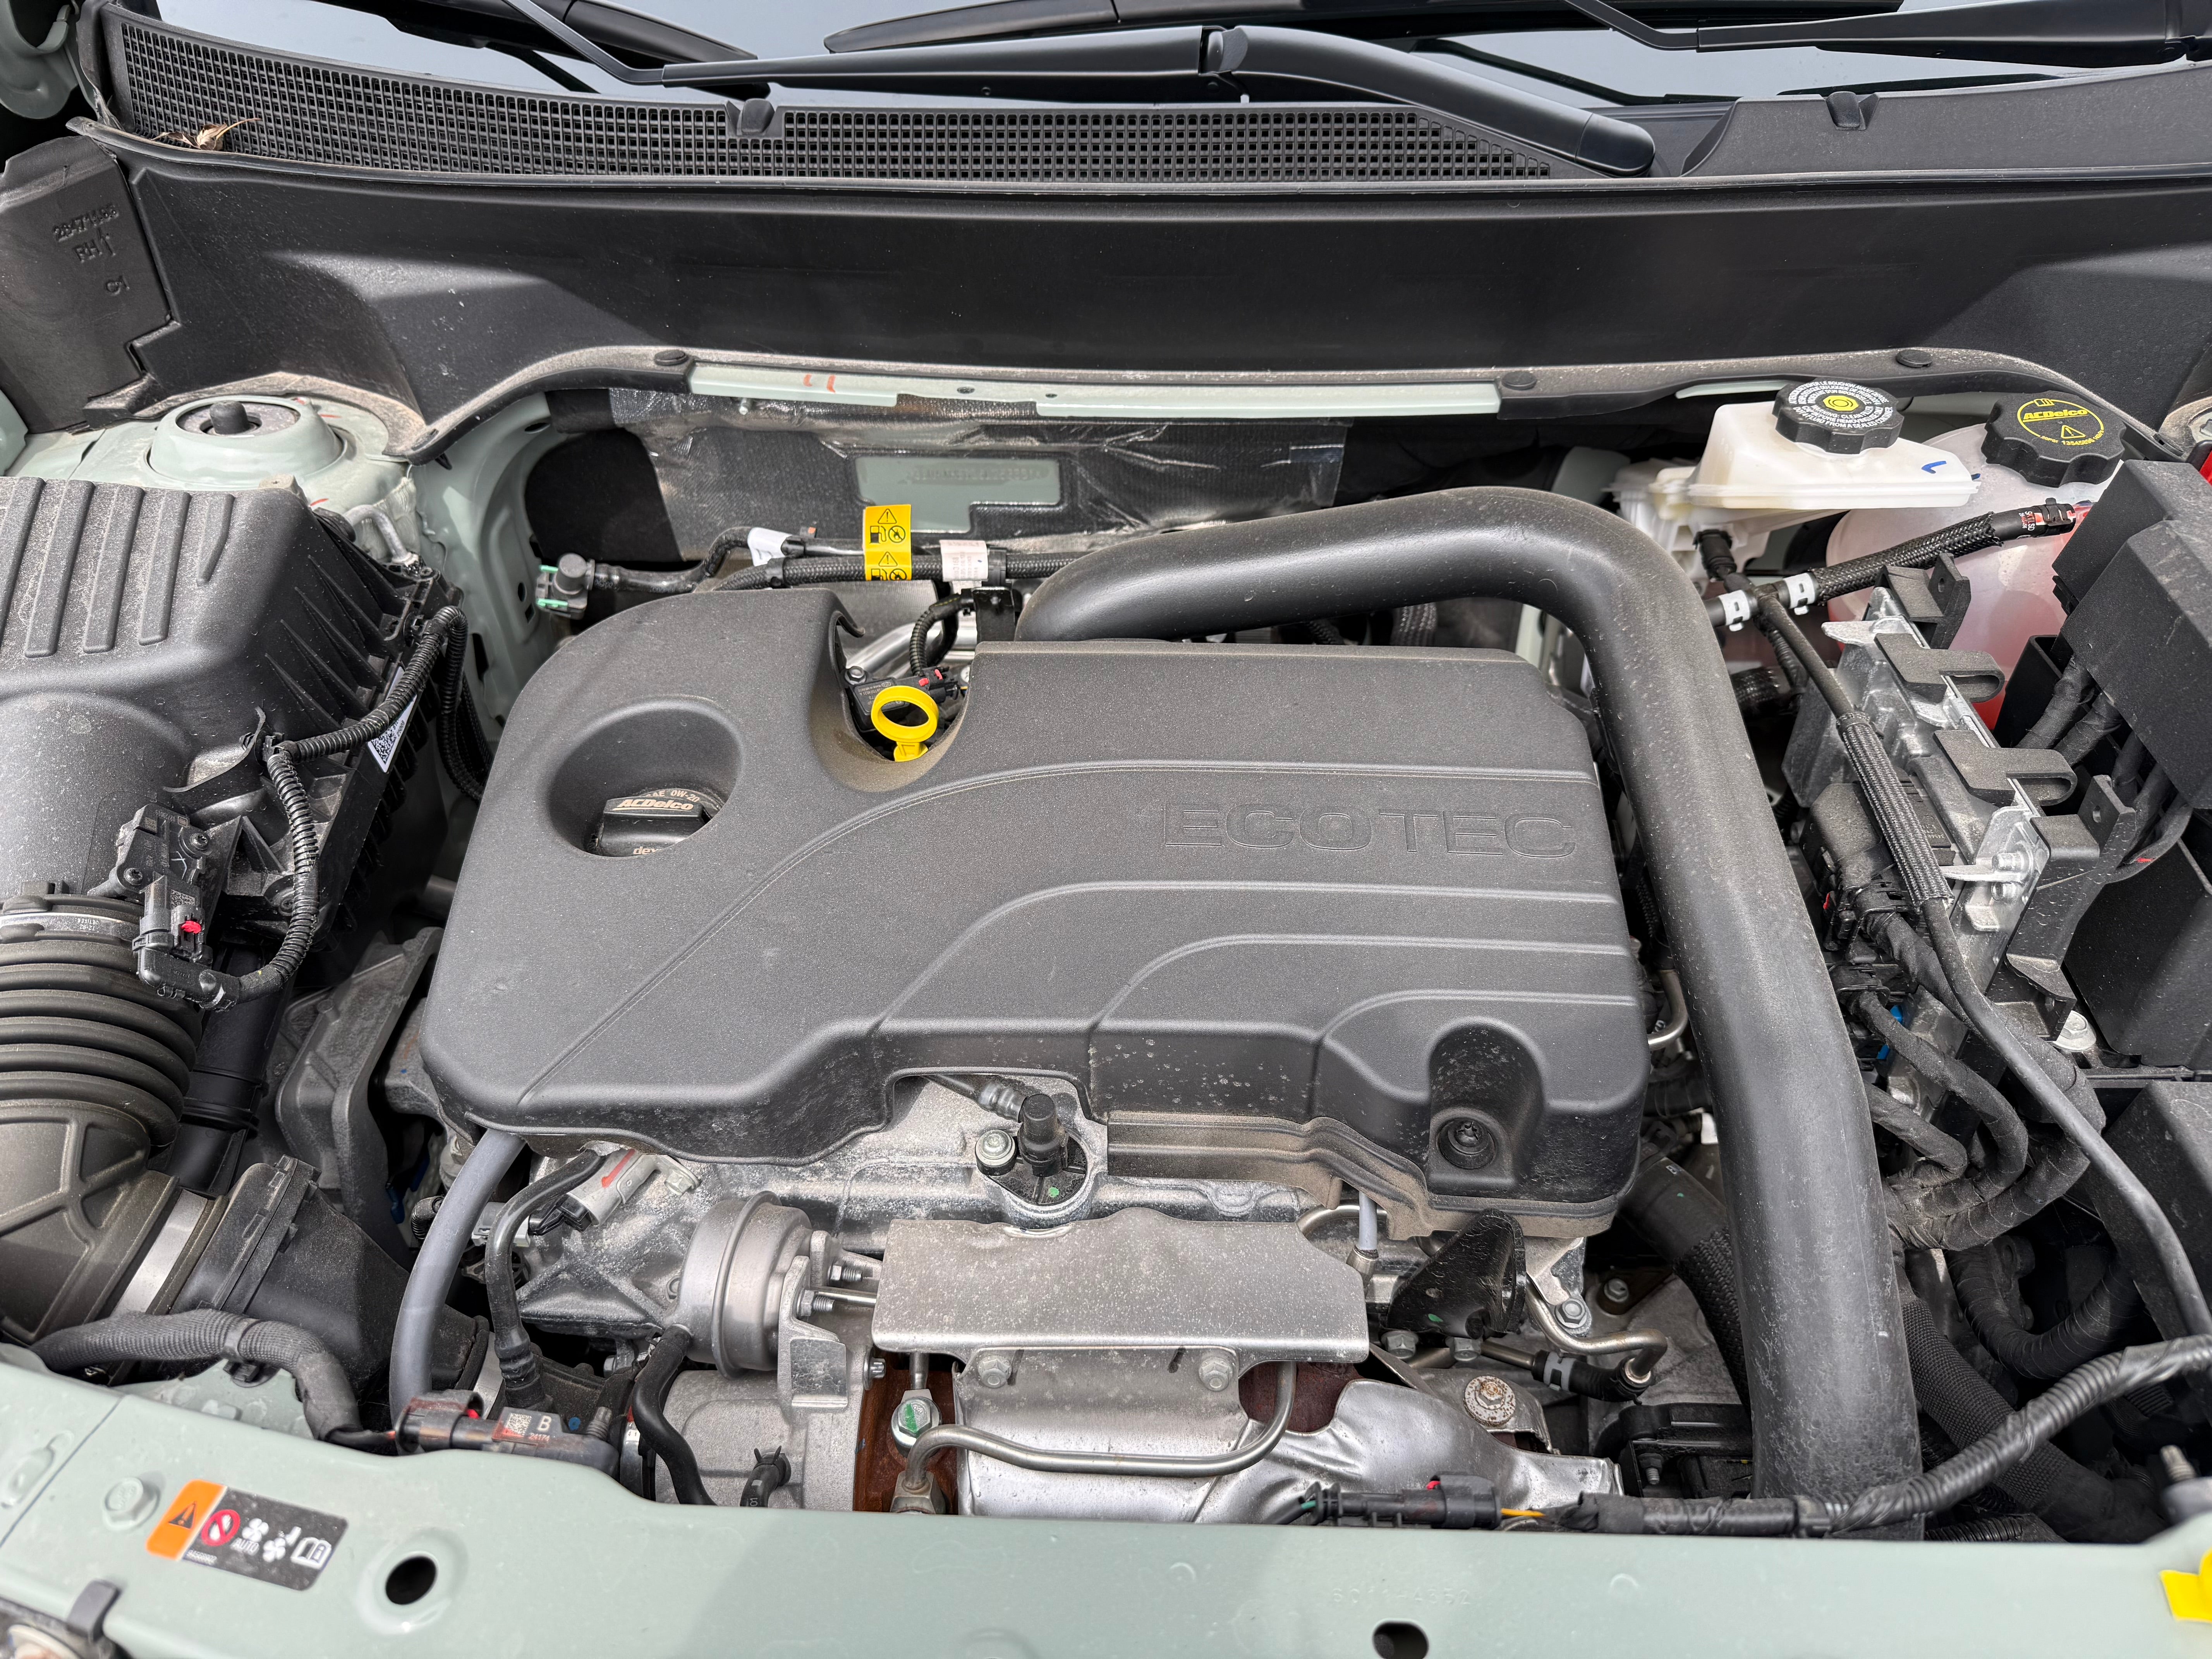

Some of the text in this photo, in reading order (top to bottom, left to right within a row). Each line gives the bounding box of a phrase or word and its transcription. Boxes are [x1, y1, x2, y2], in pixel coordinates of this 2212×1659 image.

[2023, 409, 2088, 420] ACDelco
[671, 790, 700, 802] 0W-20
[617, 799, 694, 811] ACDelco
[1164, 802, 1576, 858] ECOTEC
[538, 1415, 552, 1432] B
[231, 1537, 259, 1556] AUTO
